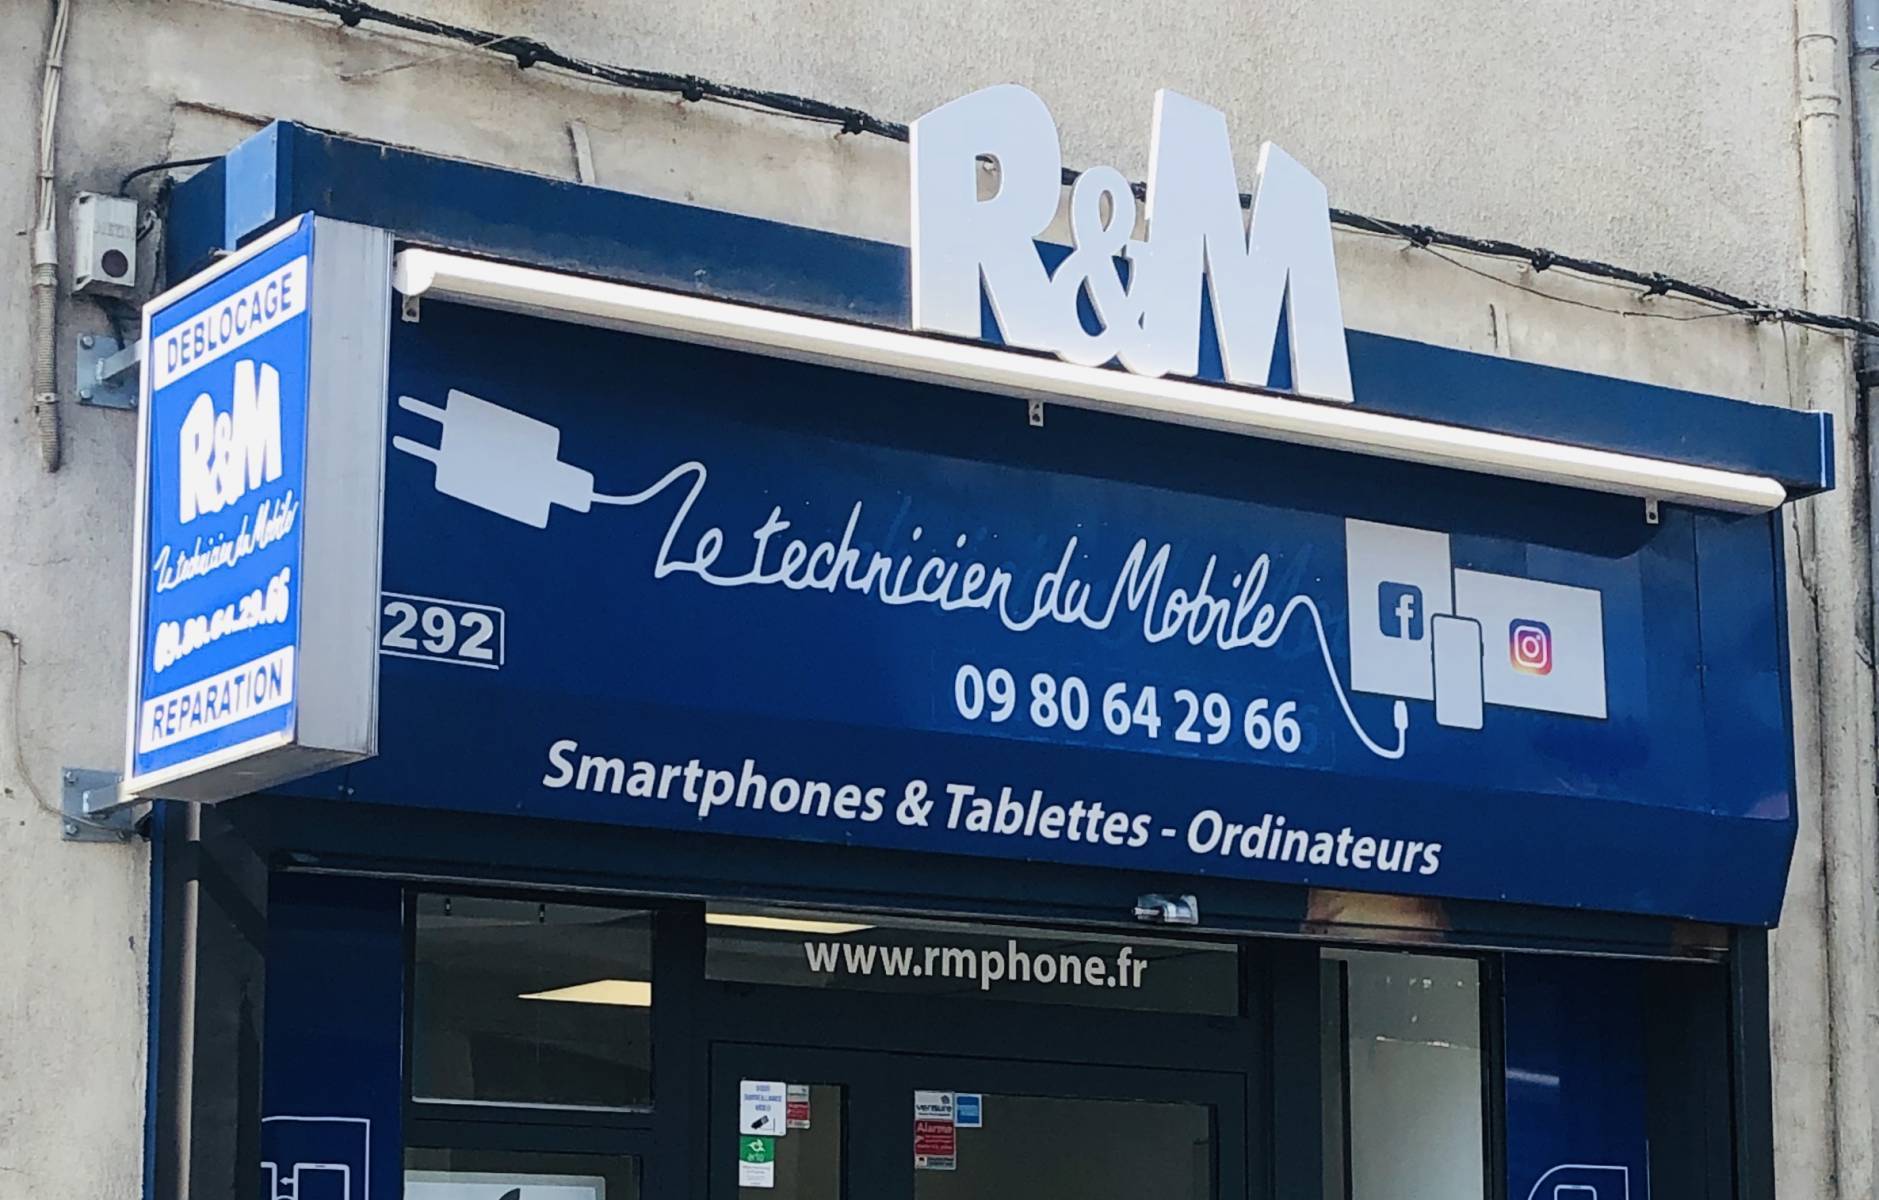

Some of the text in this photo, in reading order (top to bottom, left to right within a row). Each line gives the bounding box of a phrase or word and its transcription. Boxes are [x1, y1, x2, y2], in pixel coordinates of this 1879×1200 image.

[908, 83, 1354, 403] R&M
[166, 273, 292, 374] DEBLOCAGE
[180, 358, 282, 524] R&M
[655, 462, 1284, 650] Le technicien du Mobile
[382, 601, 494, 660] 292
[152, 658, 283, 742] REPARATION
[955, 664, 1301, 754] 09 80 64 29 66
[542, 739, 884, 822] Smartphones
[896, 779, 935, 826] &
[945, 782, 1151, 849] Tablettes
[1187, 809, 1442, 876] Ordinateurs
[804, 939, 1147, 990] www.rmphone.fr
